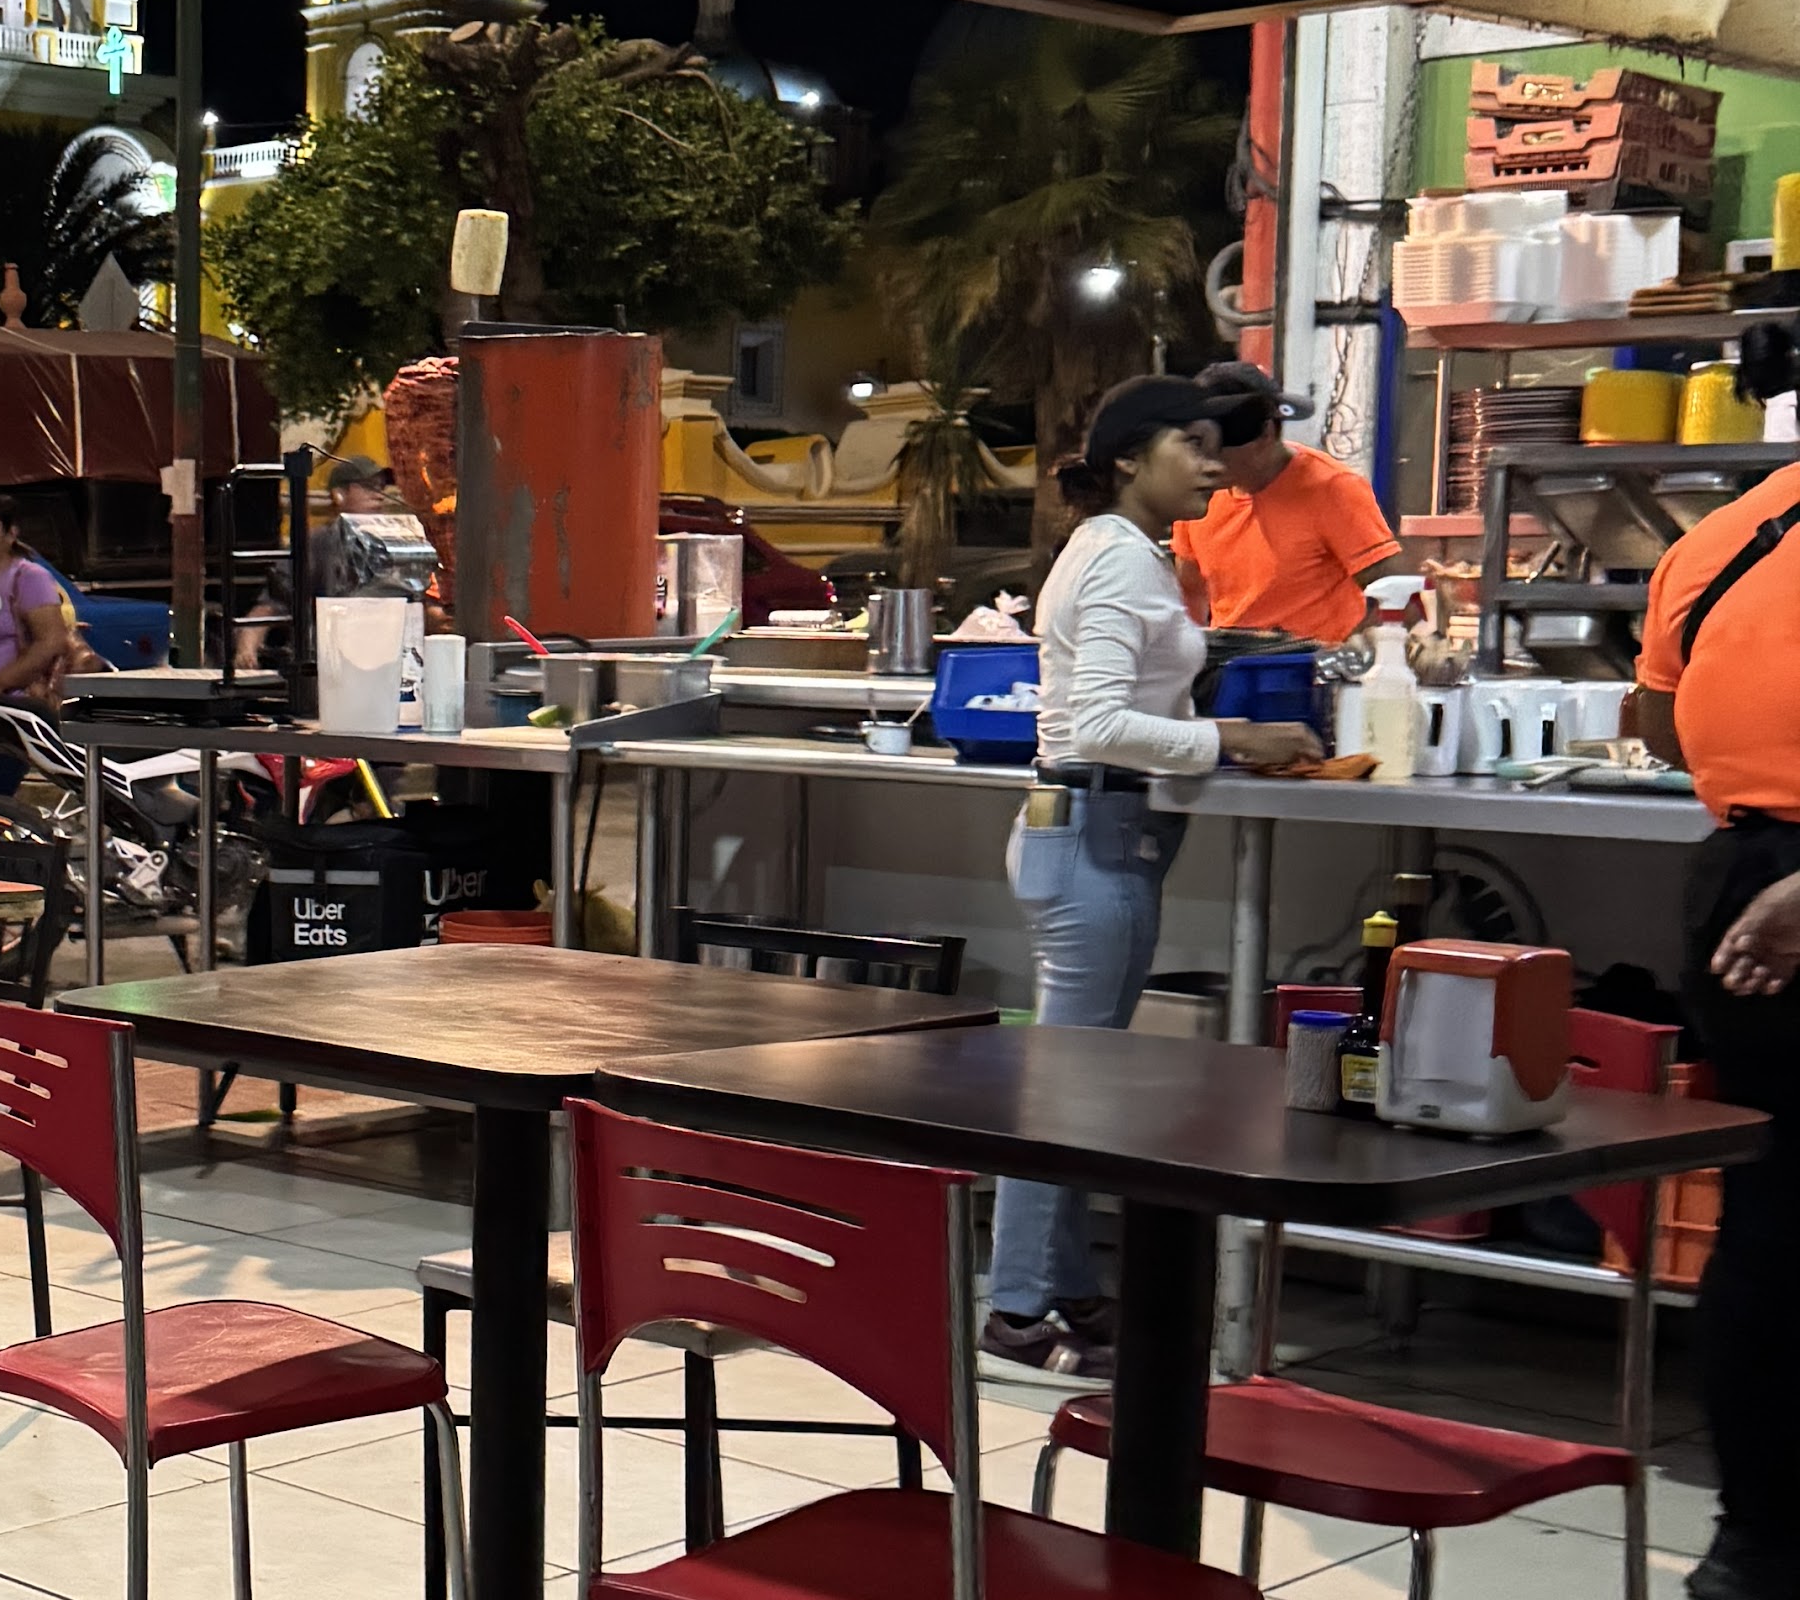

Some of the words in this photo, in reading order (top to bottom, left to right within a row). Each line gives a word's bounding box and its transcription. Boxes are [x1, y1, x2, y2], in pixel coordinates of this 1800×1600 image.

[425, 867, 488, 906] Uber
[294, 898, 346, 920] Uber
[294, 923, 347, 946] Eats
